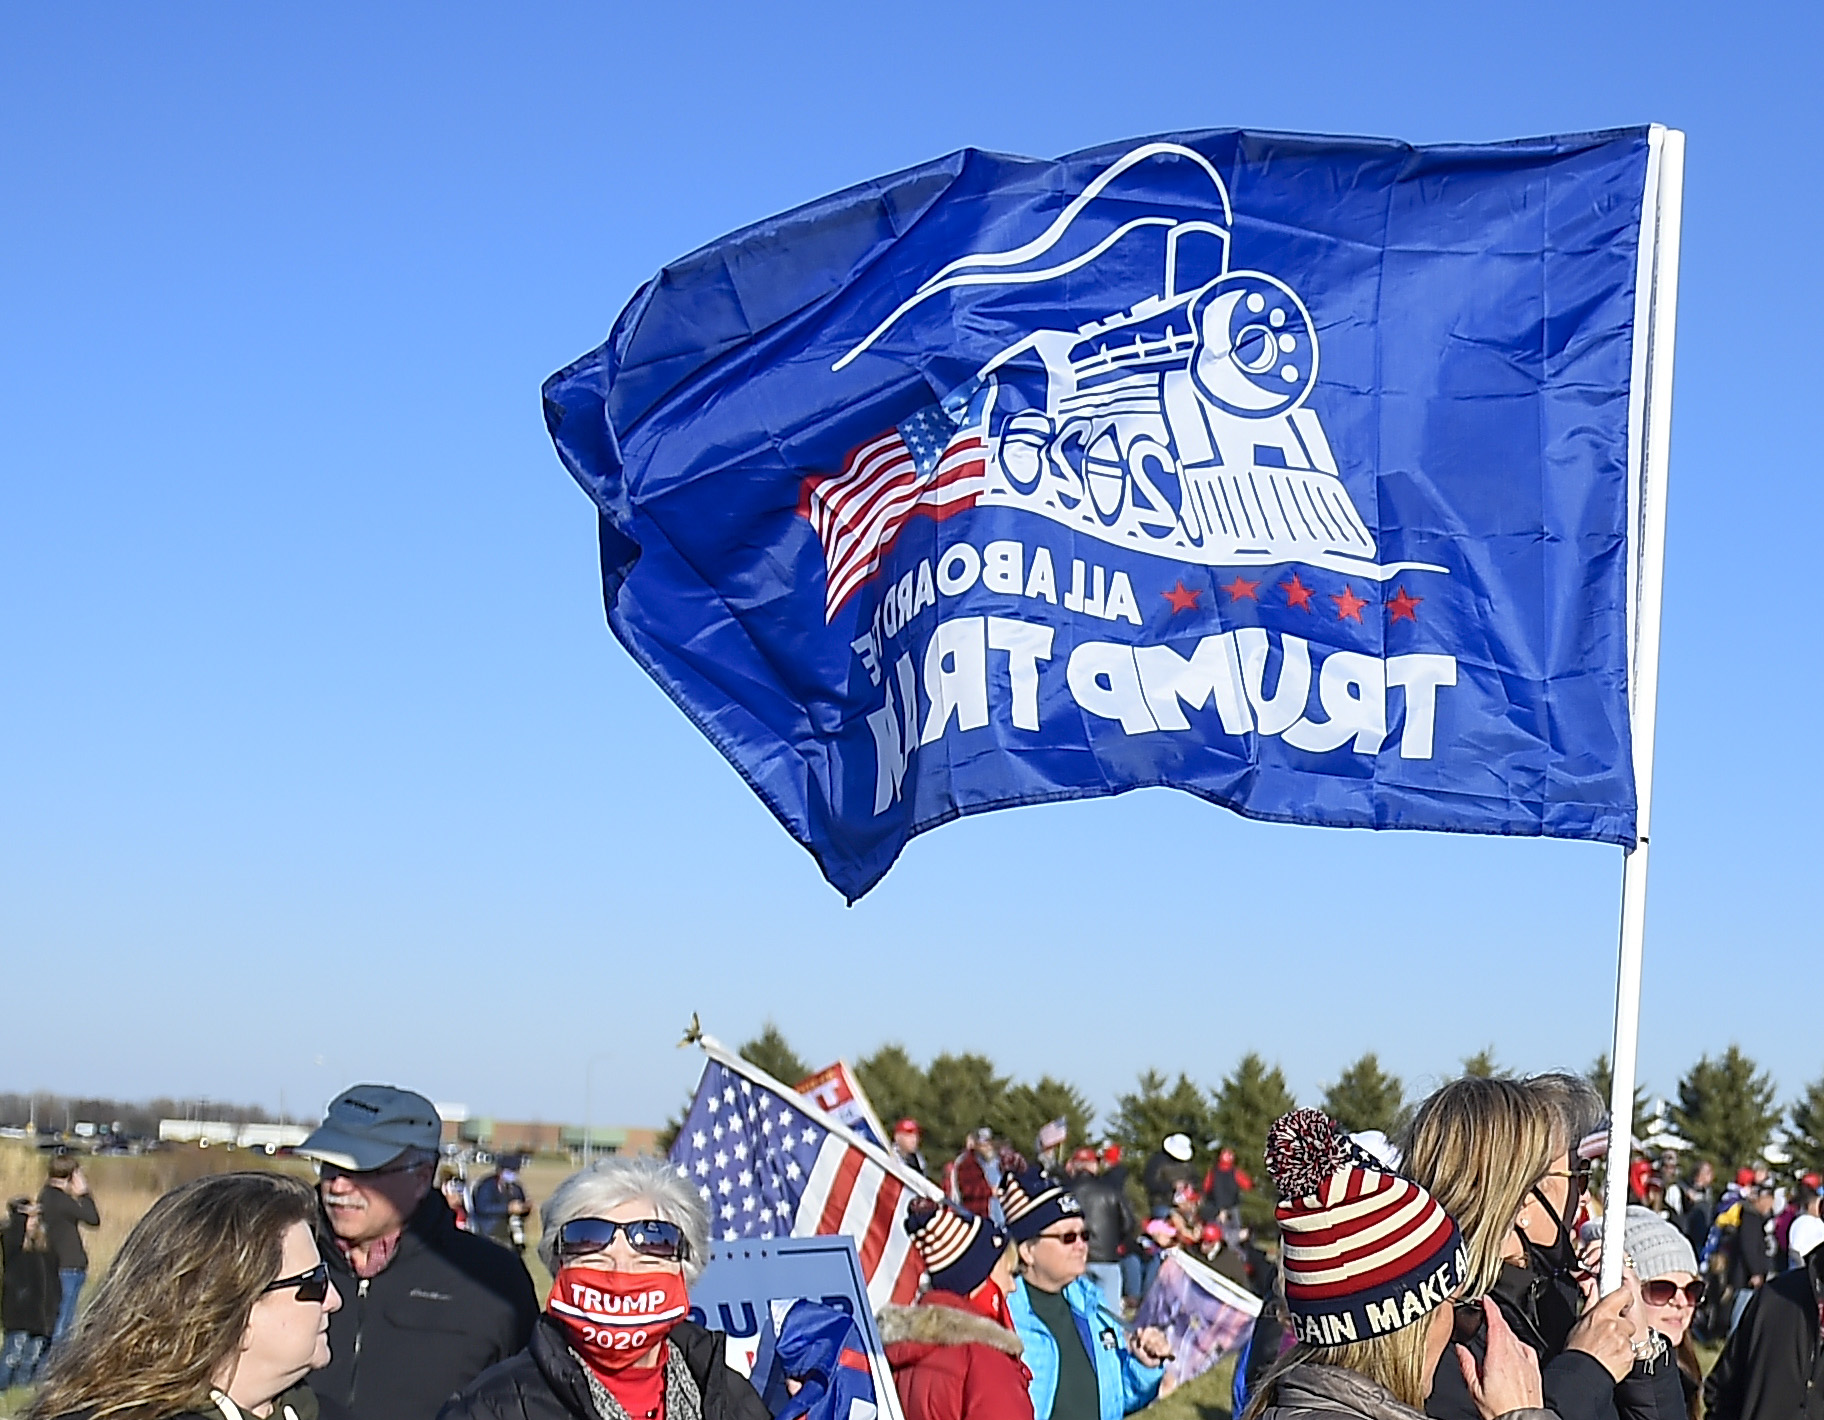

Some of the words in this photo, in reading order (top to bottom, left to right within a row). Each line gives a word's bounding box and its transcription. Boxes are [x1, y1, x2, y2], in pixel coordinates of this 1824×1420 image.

[571, 1283, 666, 1313] TRUMP
[1291, 1312, 1357, 1345] GAIN
[1365, 1263, 1456, 1334] MAKE
[582, 1326, 648, 1350] 2020
